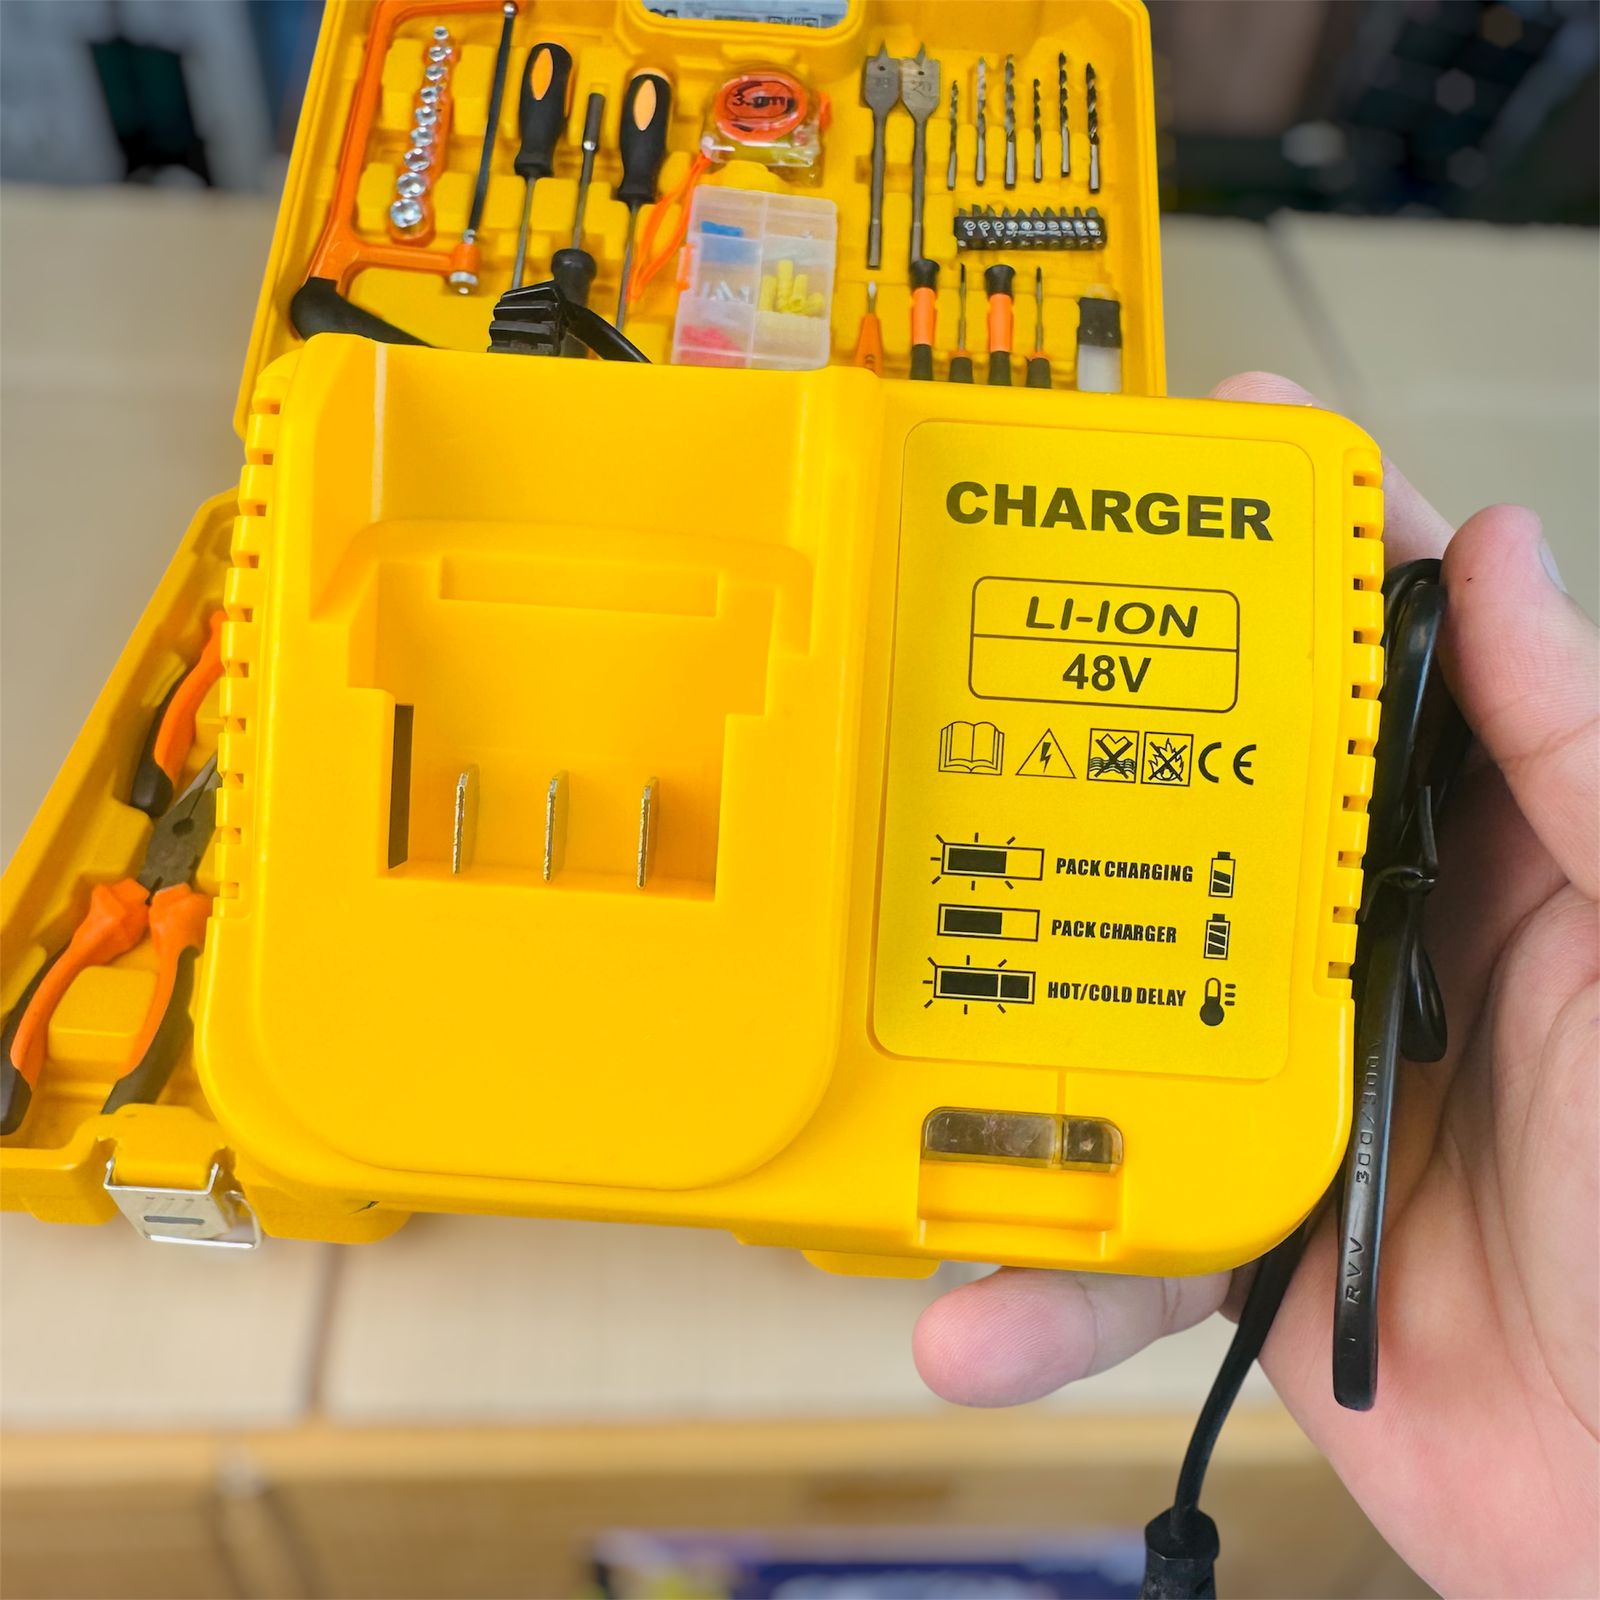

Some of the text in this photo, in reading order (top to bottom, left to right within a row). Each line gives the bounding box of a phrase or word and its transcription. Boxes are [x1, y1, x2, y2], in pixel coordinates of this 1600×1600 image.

[946, 481, 1274, 541] CHARGER
[1025, 596, 1198, 638] LI-ION
[1062, 653, 1152, 693] 48V
[1055, 857, 1193, 882] PACK CHARGING
[1051, 919, 1177, 943] PACK CHARGER
[1047, 981, 1187, 1007] HOT/COLD DELAY
